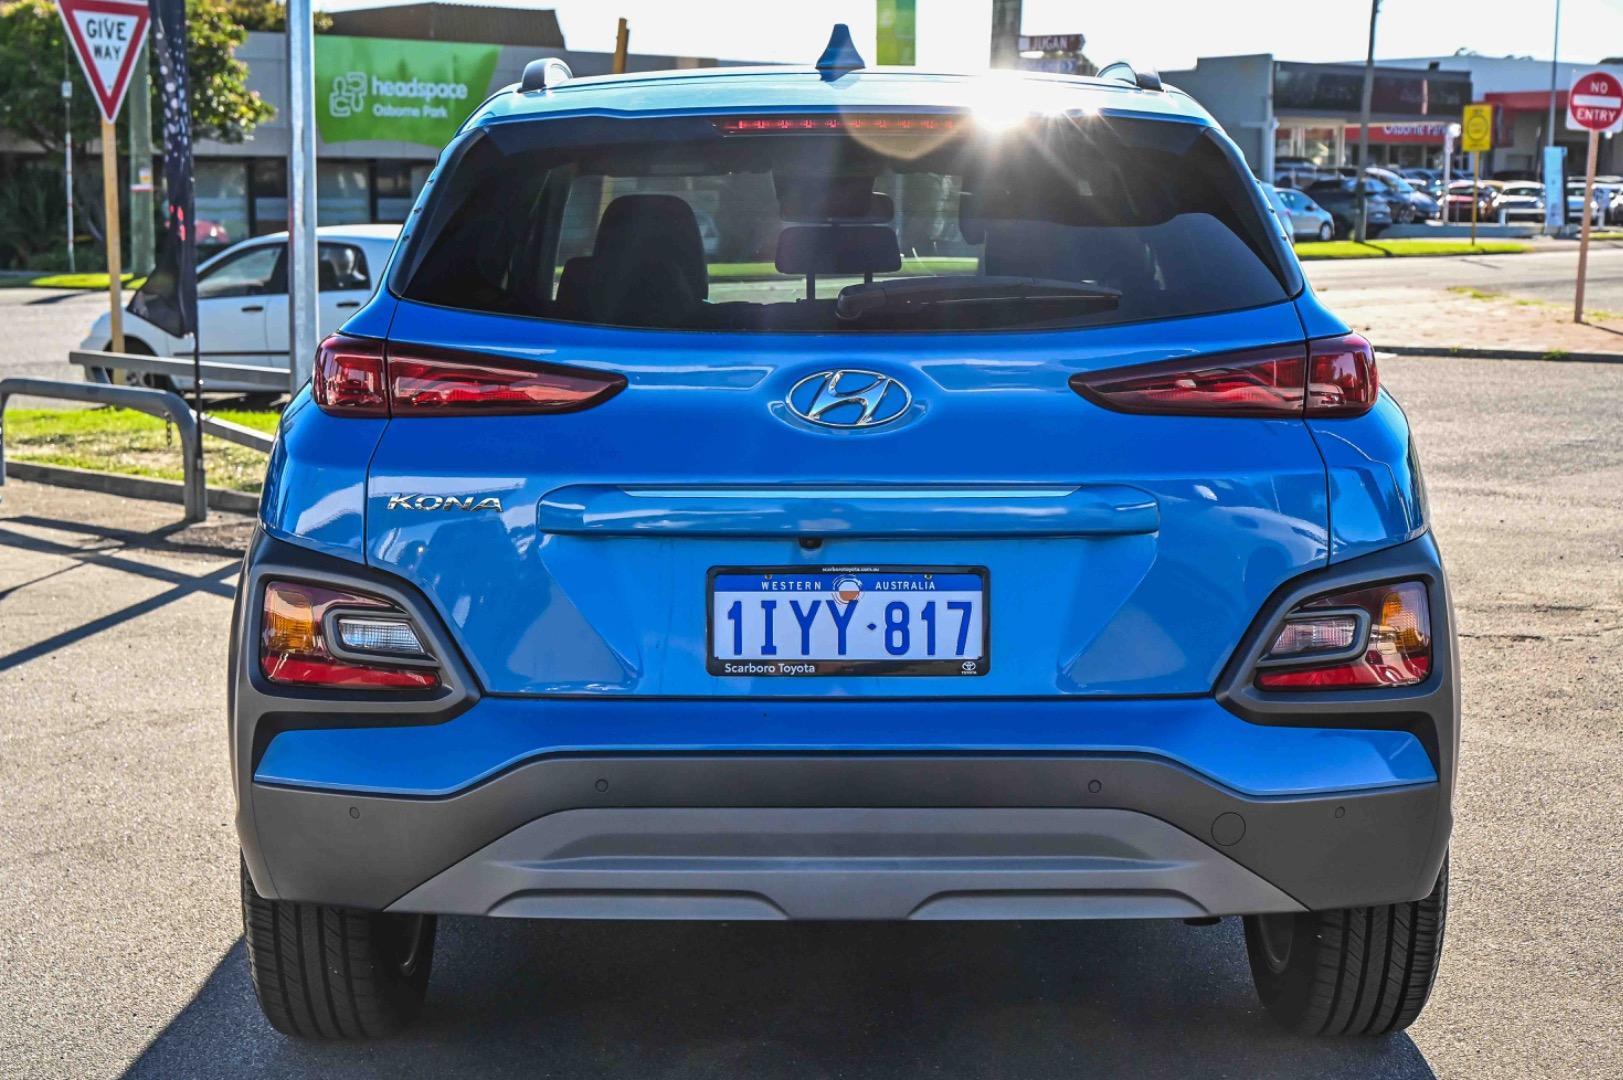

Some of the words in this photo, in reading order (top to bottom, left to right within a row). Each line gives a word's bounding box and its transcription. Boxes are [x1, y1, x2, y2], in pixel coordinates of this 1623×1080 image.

[86, 18, 127, 41] GIVE
[93, 44, 121, 60] WAY
[372, 75, 468, 102] headspace
[1590, 81, 1608, 94] NO
[373, 104, 420, 117] Osborne
[423, 105, 447, 118] Park
[1576, 109, 1617, 122] ENTRY
[387, 492, 503, 513] KONA
[761, 581, 822, 591] WESTERN
[875, 581, 936, 591] AUSTRALIA
[724, 663, 776, 674] Scarboro
[778, 663, 816, 675] Toyota
